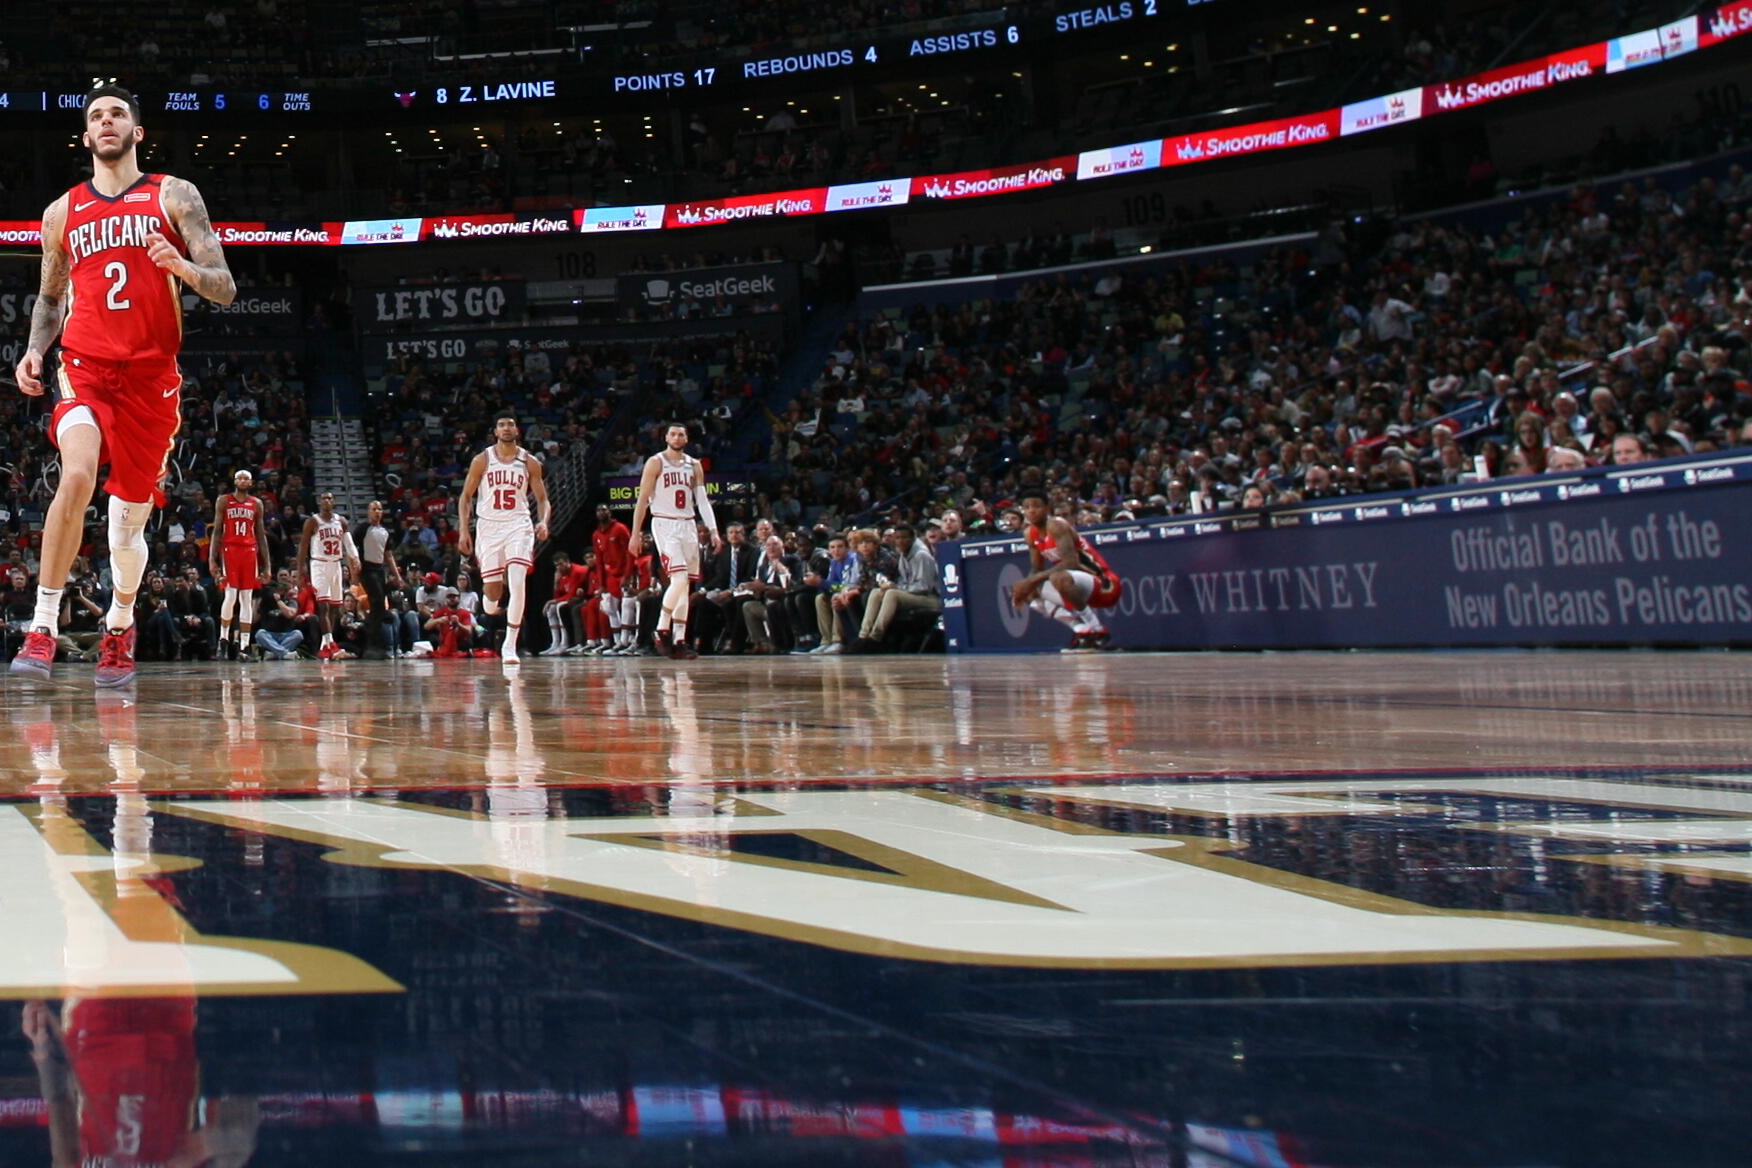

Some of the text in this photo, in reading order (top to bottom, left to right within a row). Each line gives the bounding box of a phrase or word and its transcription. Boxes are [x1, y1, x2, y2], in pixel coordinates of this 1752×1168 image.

[1055, 1, 1134, 33] STEALS
[909, 24, 1021, 57] ASSISTS 6
[743, 45, 878, 79] REBOUNDS 4
[613, 68, 716, 92] POINTS 17
[166, 92, 197, 101] TEAM
[214, 94, 225, 110] 5
[258, 94, 269, 110] 6
[284, 92, 309, 101] TIME
[435, 80, 556, 104] 8 Z. LAVINE
[165, 101, 200, 111] FOULS
[282, 101, 311, 111] OUTS
[68, 214, 161, 264] PELICANS
[555, 251, 596, 280] 108
[104, 261, 130, 311] 2
[680, 274, 775, 299] SeatGeek
[209, 297, 293, 315] SeatGeek
[375, 285, 506, 321] LET'S GO
[441, 338, 466, 358] GO
[487, 470, 524, 489] BULLS
[493, 489, 516, 510] 15
[609, 486, 632, 500] BIG
[234, 520, 247, 537] 14
[319, 527, 344, 541] BULLS
[323, 540, 340, 555] 32
[1451, 510, 1722, 573] Official Bank of the
[1189, 561, 1379, 614] WHITNEY
[1444, 575, 1752, 629] New Orleans Pelicans
